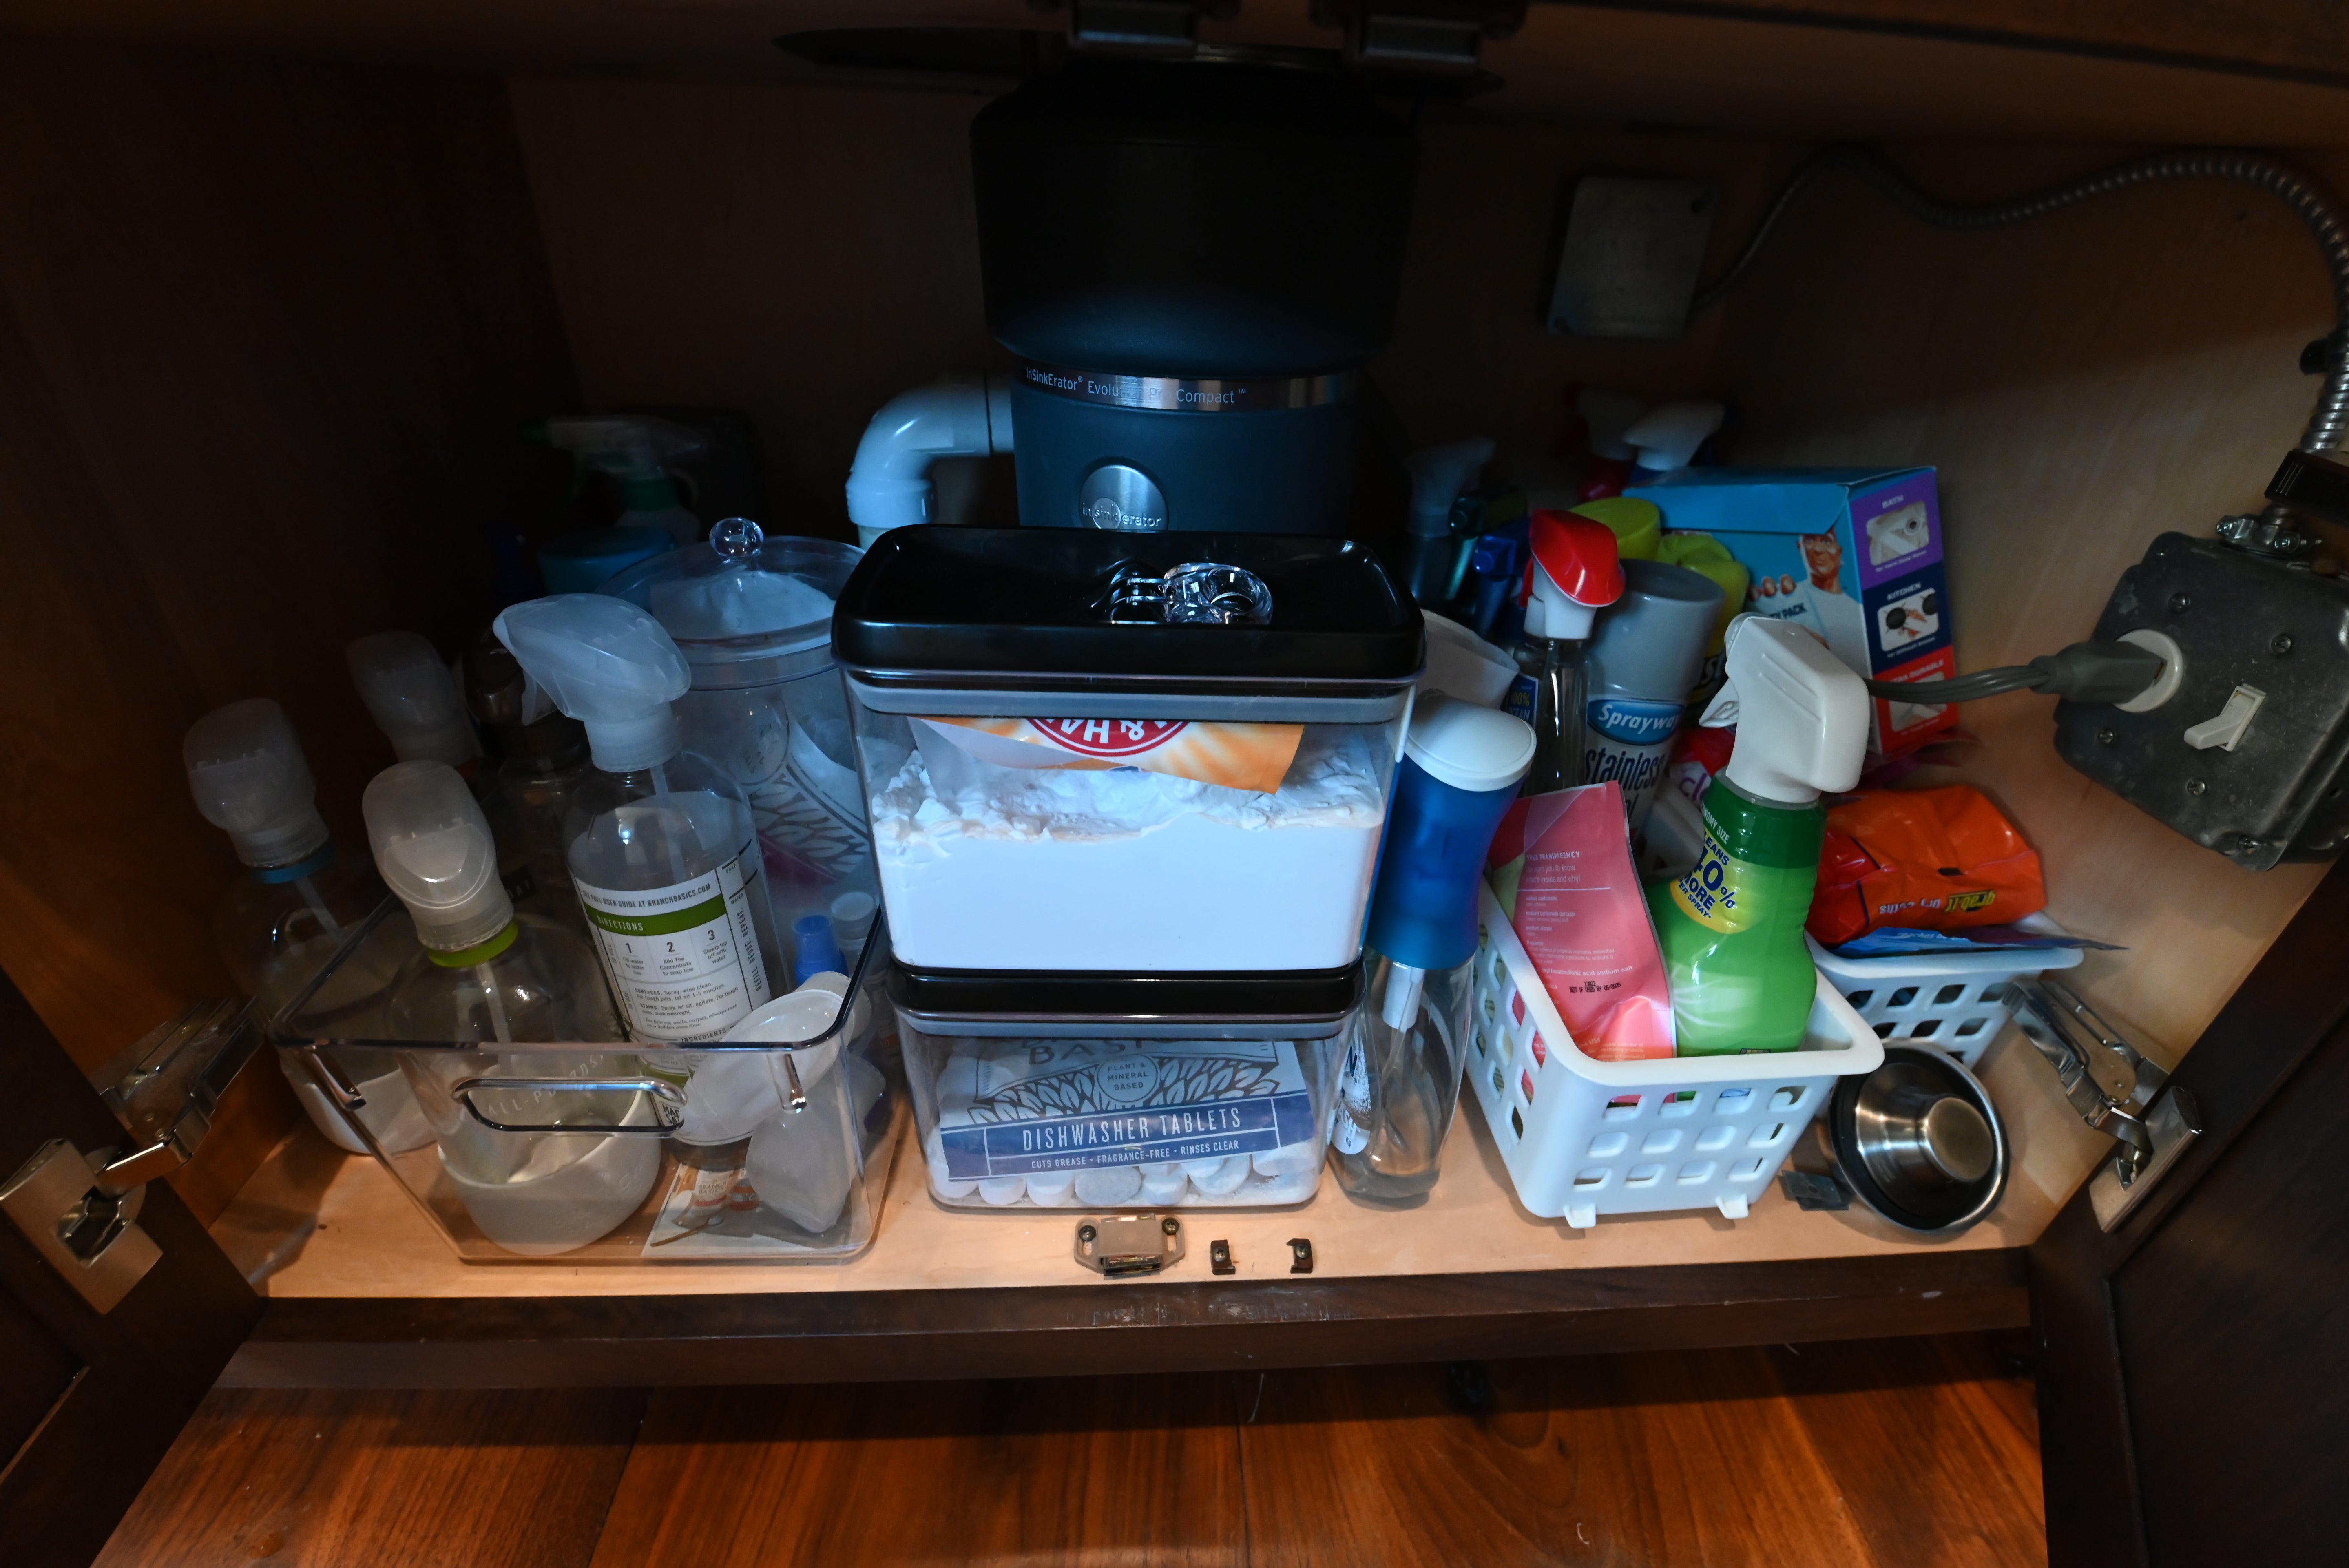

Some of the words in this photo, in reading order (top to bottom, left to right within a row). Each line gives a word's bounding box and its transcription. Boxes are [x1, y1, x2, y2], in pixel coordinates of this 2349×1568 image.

[1881, 494, 1904, 509] BATH
[1887, 582, 1921, 601] KITCHEN
[1716, 826, 1730, 845] SIZE
[1539, 851, 1580, 860] TRANSPARENCY
[725, 863, 737, 874] SOAP
[603, 897, 617, 907] USER
[617, 900, 637, 908] GUIDE
[647, 882, 711, 907] BRANCHBASICS.COM
[730, 892, 744, 905] WATER
[597, 915, 644, 931] DIRECTIONS
[737, 907, 749, 938] REPEAT.
[707, 929, 715, 941] 3
[625, 942, 632, 953] 1
[666, 941, 675, 953] 2
[703, 945, 719, 955] Slowly
[719, 940, 728, 949] top
[716, 948, 727, 957] with
[744, 937, 756, 964] REUSE.
[712, 955, 726, 964] water
[659, 961, 692, 971] Concentrate
[751, 963, 763, 992] REFILL.
[703, 984, 725, 995] minutes.
[725, 986, 739, 997] tough
[708, 1009, 727, 1019] always
[681, 1028, 727, 1043] INGREDIENTS
[1106, 1071, 1148, 1081] MINERAL
[1113, 1081, 1145, 1091] BASED
[1023, 1117, 1150, 1151] DISHWASHER
[1159, 1107, 1241, 1136] TABLETS
[1031, 1158, 1052, 1169] CUTS
[1055, 1156, 1086, 1167] GREASE
[1097, 1148, 1170, 1164] FRAGRANCE-FREE
[1181, 1143, 1210, 1155] RINSES
[1213, 1140, 1239, 1151] CLEAR
